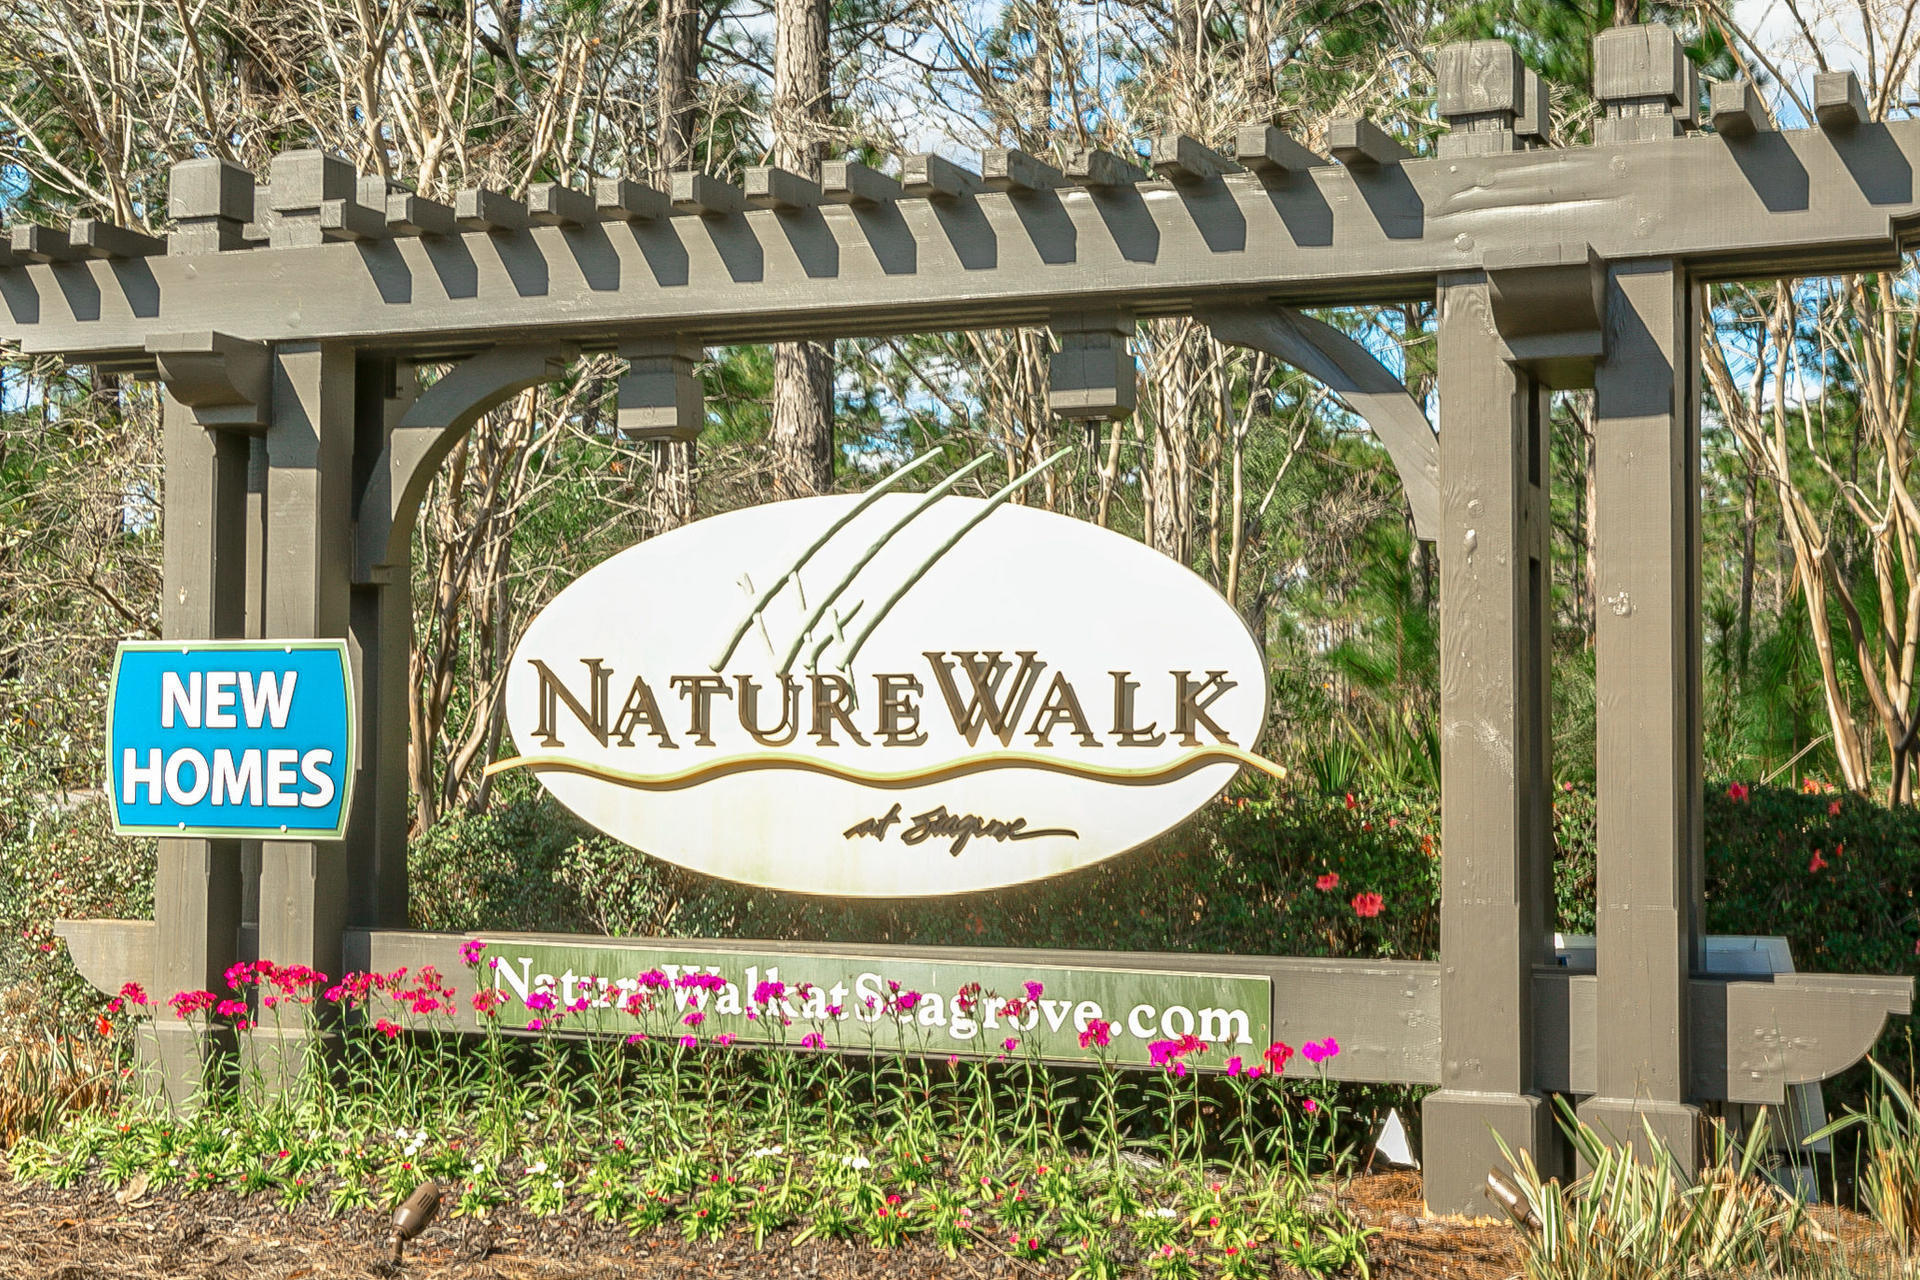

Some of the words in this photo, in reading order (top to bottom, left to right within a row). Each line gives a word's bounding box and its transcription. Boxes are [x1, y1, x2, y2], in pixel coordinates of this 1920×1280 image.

[161, 670, 298, 728] NEW
[122, 747, 336, 808] HOMES
[842, 802, 902, 842] at
